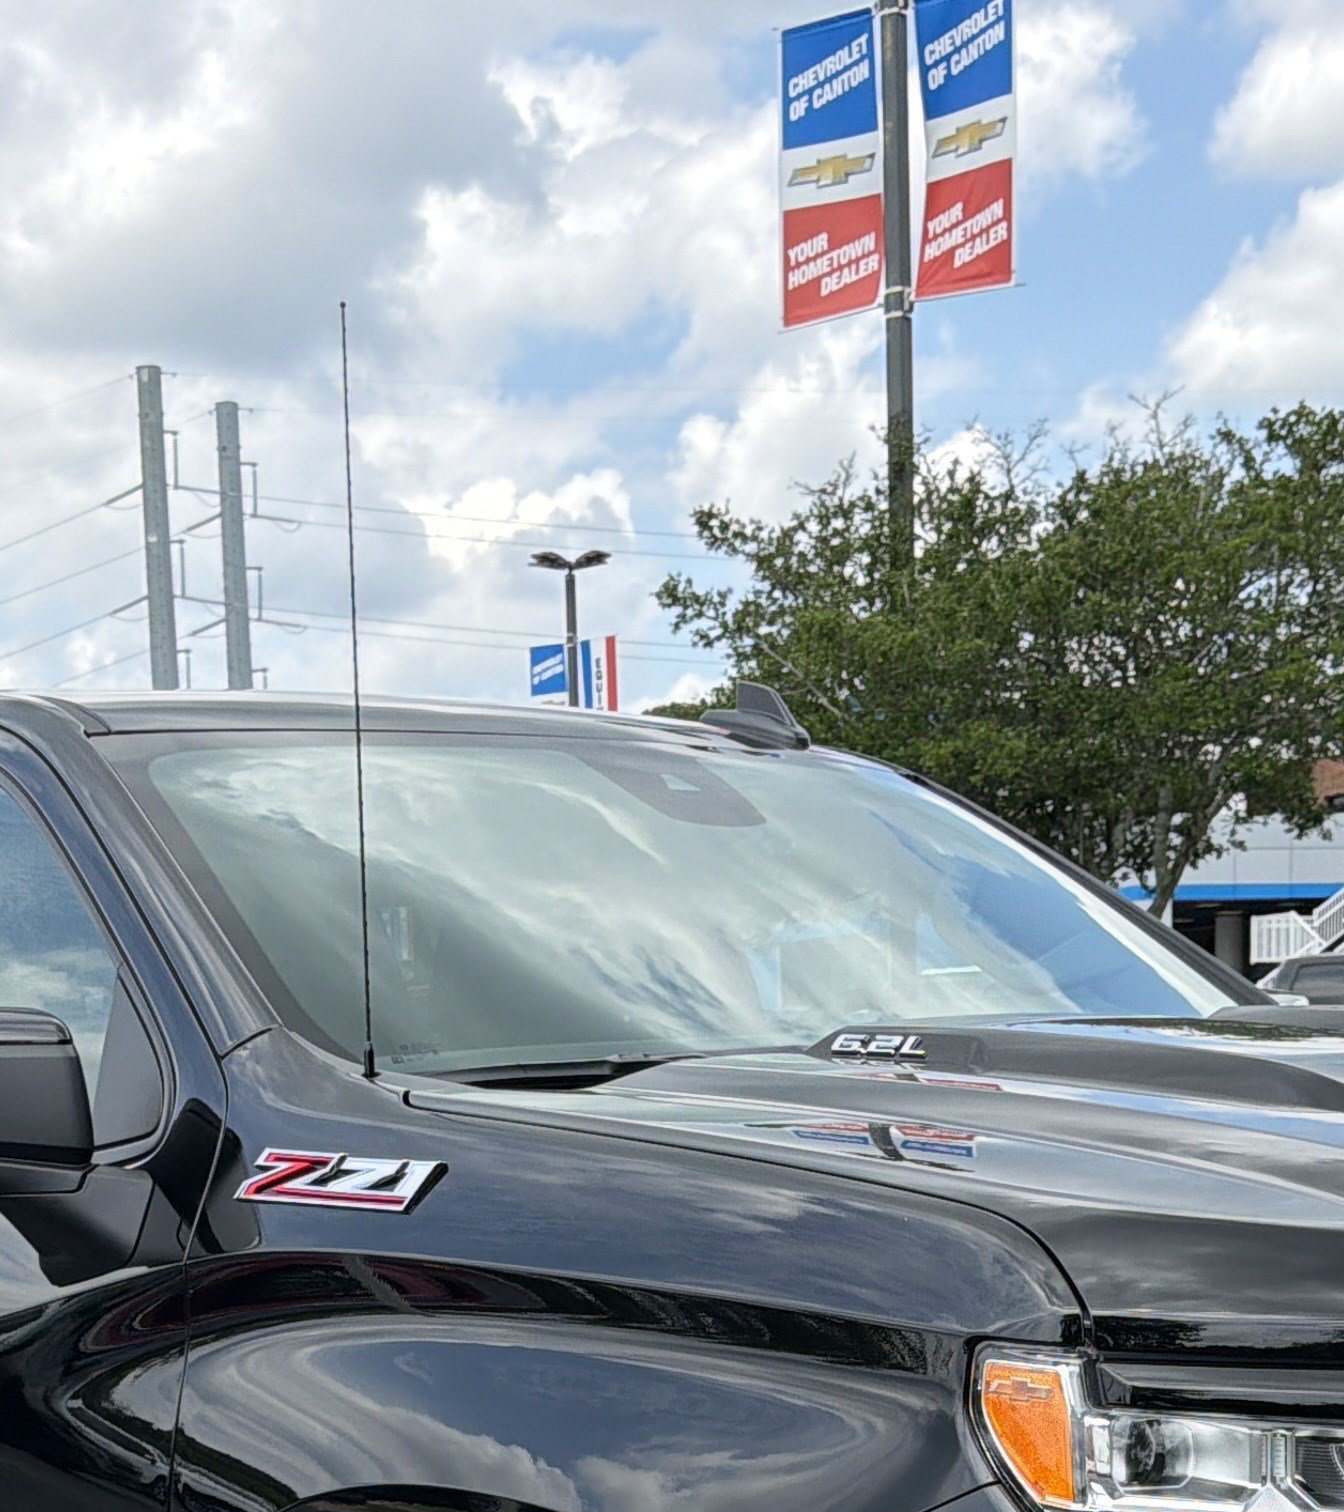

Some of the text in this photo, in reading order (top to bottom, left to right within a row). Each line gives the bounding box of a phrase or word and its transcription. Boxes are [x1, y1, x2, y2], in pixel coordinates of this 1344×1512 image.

[923, 0, 1004, 65] CHEVROLET
[927, 20, 1005, 90] OF CANTON
[788, 32, 869, 98] CHEVROLET
[789, 58, 870, 121] OF CANTON
[787, 231, 828, 267] YOUR
[923, 197, 1004, 263] HOMETOWN
[927, 201, 964, 239] YOUR
[953, 220, 1008, 269] DEALER
[788, 231, 876, 291] HOMETOWN
[820, 252, 880, 298] DEALER
